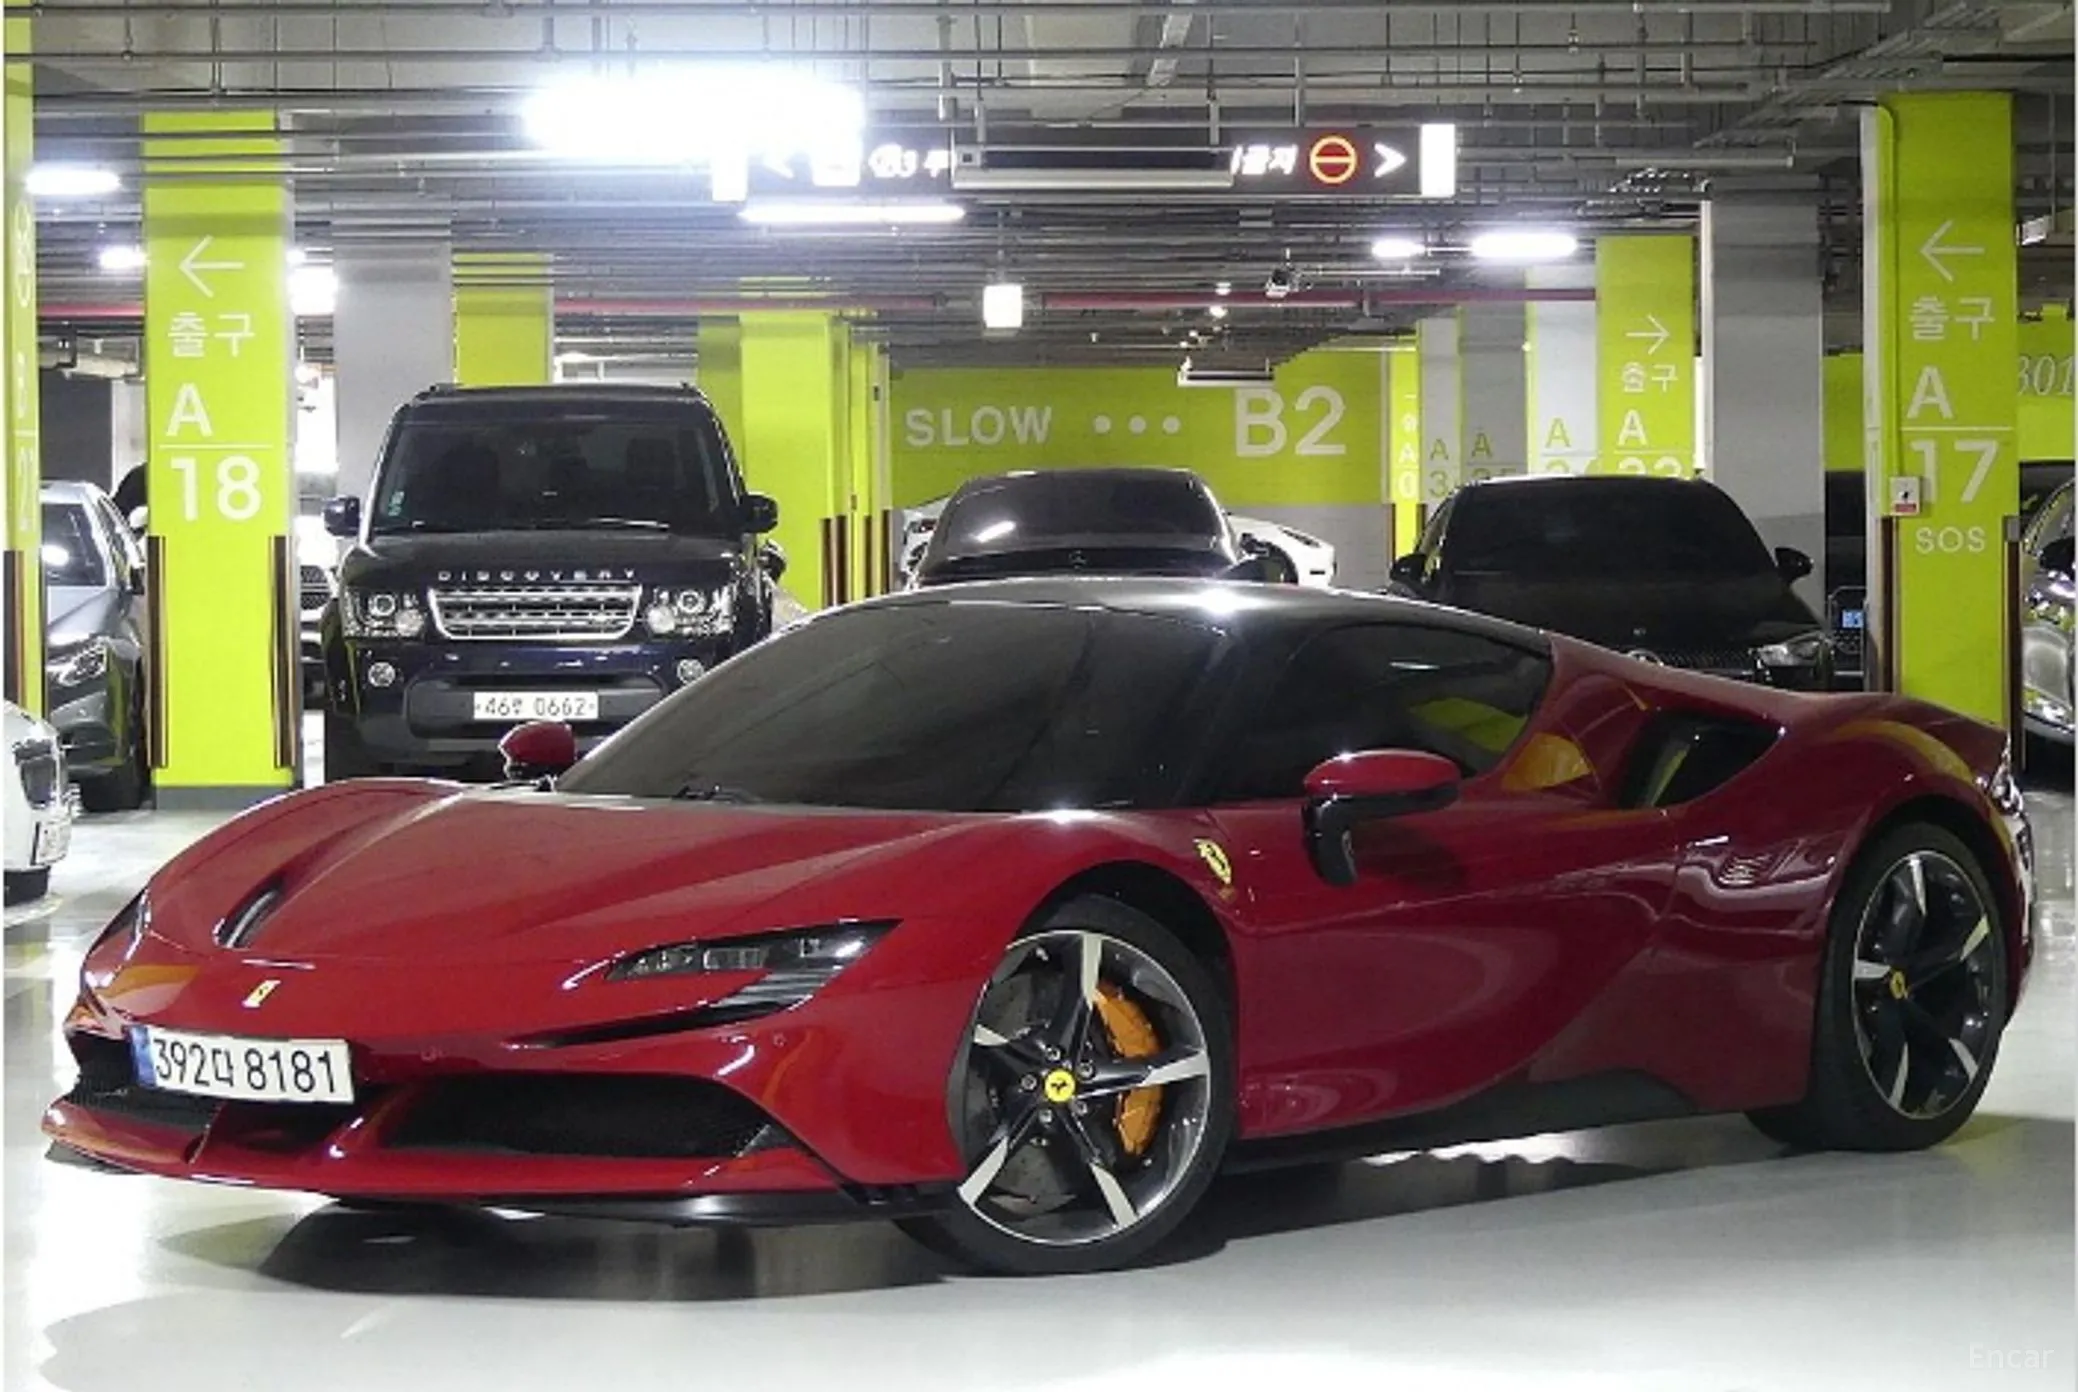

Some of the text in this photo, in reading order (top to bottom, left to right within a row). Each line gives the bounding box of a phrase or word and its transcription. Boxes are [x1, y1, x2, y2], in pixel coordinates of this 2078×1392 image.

[167, 312, 256, 357] 출구
[1909, 296, 1996, 341] 출구
[1622, 362, 1678, 392] 출구
[1906, 366, 1953, 419] A
[166, 383, 213, 437] A
[905, 386, 1347, 457] SLOW B2
[1617, 409, 1648, 446] A
[1429, 438, 1449, 461] A
[1471, 432, 1493, 458] A
[1545, 417, 1571, 449] A
[170, 455, 262, 522] 18
[1910, 440, 1999, 504] 17
[1916, 526, 1986, 553] SOS
[437, 568, 636, 583] DISCOVERY
[153, 1038, 334, 1093] 392다 8181
